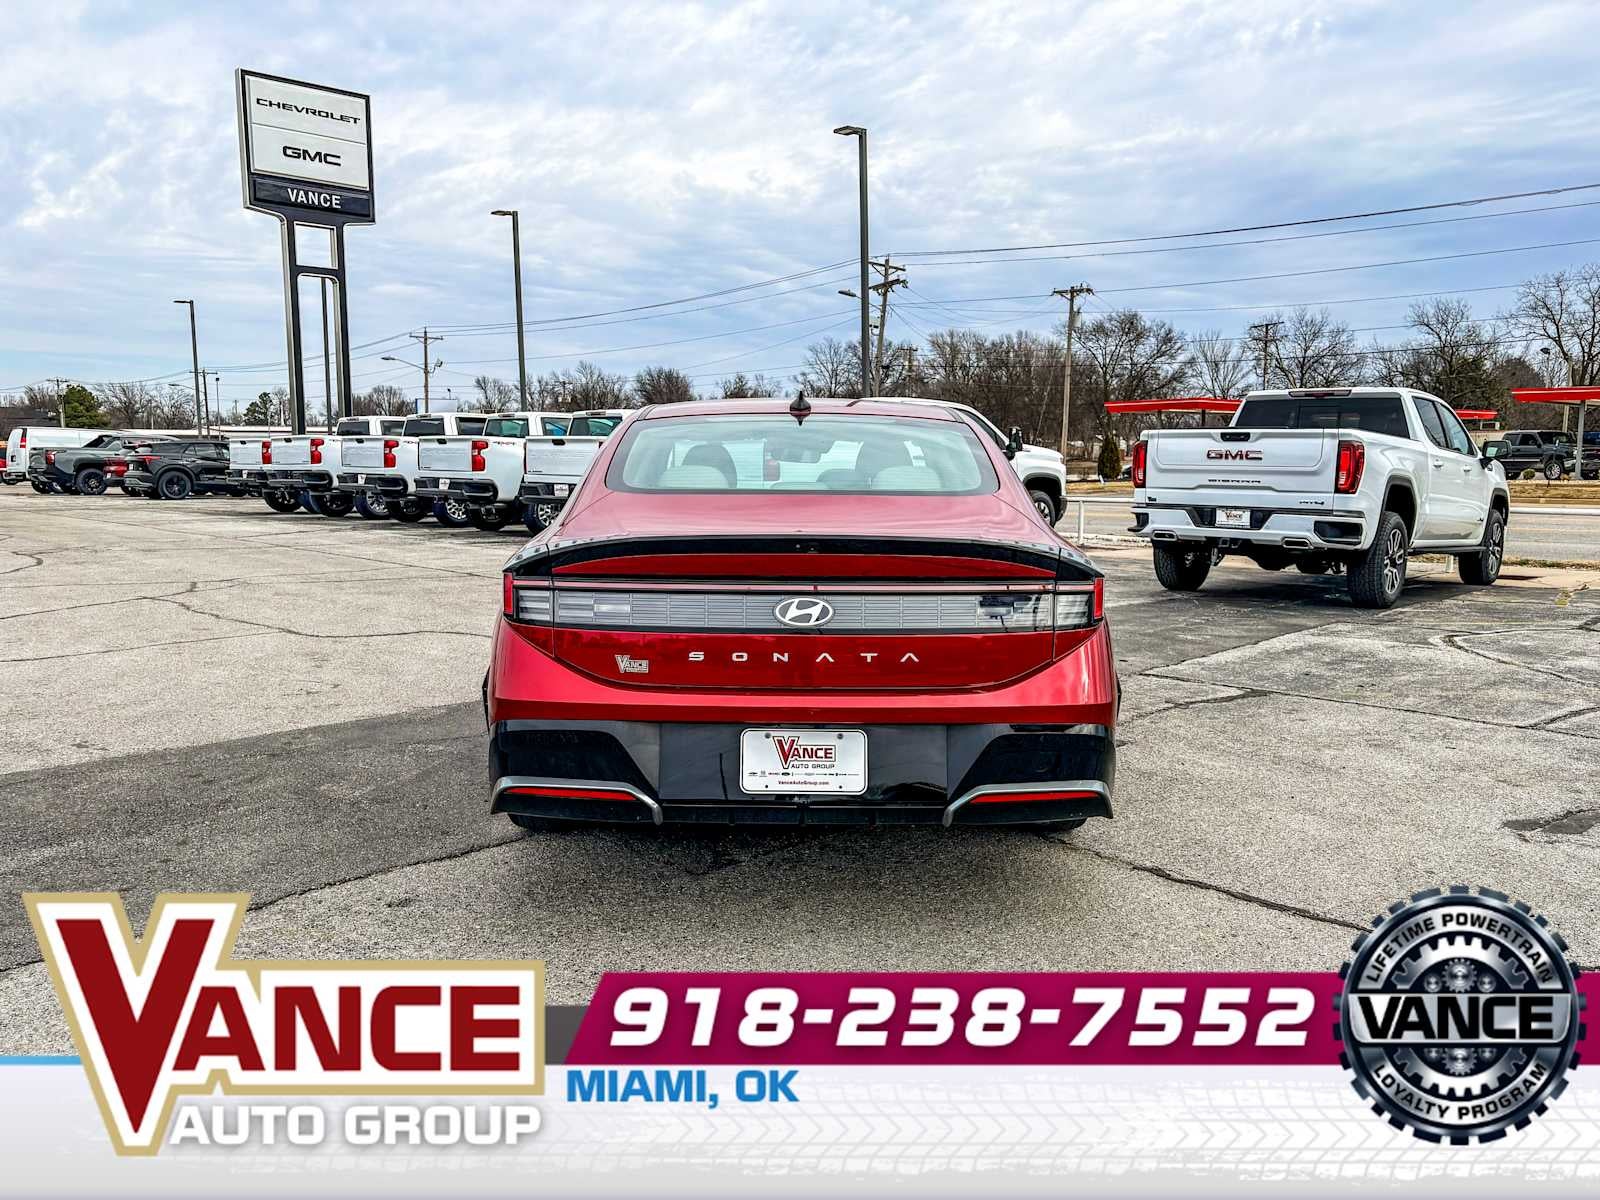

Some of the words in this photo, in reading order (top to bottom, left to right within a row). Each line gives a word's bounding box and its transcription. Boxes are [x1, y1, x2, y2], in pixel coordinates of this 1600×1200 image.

[256, 98, 360, 124] CHEVROLET
[282, 145, 341, 166] GMC
[287, 188, 341, 208] VANCE
[1207, 449, 1263, 461] GMC
[688, 652, 919, 662] SONATA
[775, 738, 834, 767] VANCE
